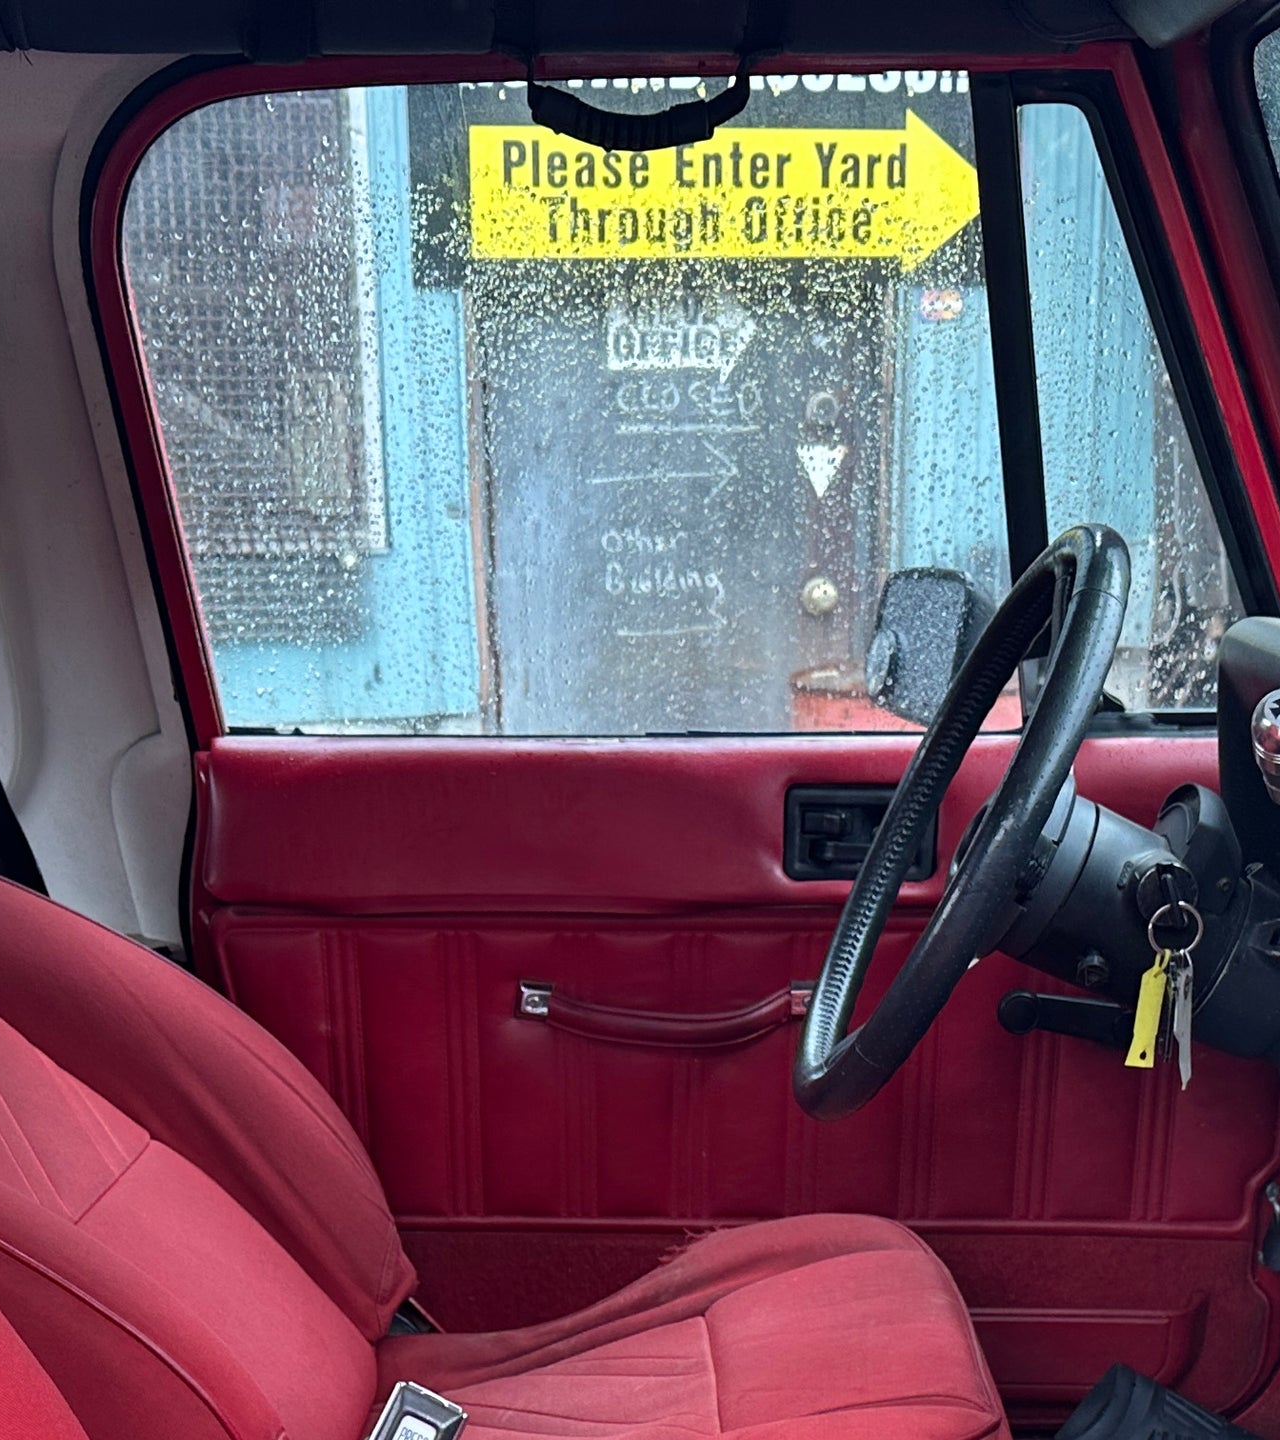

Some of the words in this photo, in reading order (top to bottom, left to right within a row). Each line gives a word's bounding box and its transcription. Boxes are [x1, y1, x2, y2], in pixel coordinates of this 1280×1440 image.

[502, 139, 651, 189] Please
[675, 143, 793, 189] Enter
[814, 142, 907, 189] Yard
[547, 198, 720, 251] Through
[741, 196, 874, 246] Office
